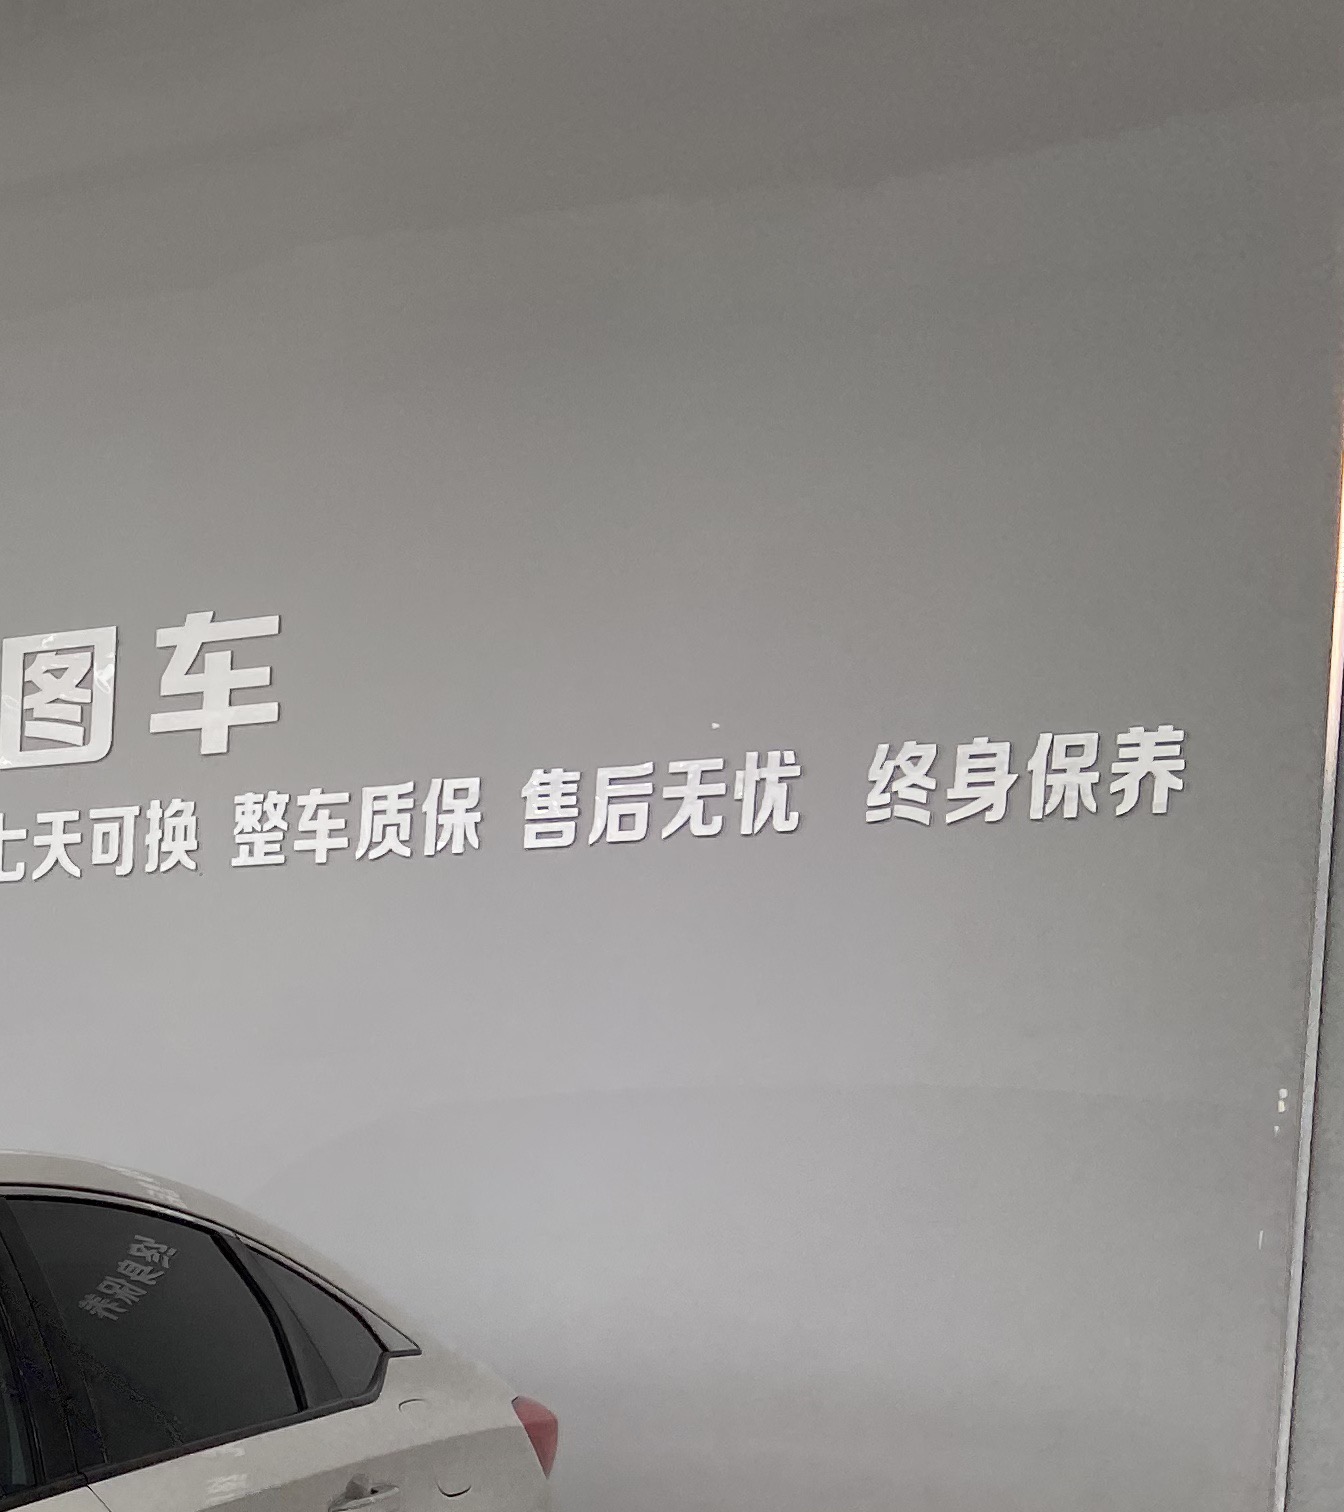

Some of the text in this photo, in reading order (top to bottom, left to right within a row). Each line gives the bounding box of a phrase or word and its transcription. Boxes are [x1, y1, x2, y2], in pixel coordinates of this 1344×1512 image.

[231, 776, 483, 868] 整车质保
[520, 749, 802, 850] 售后无忧
[864, 724, 1187, 826] 终身保养
